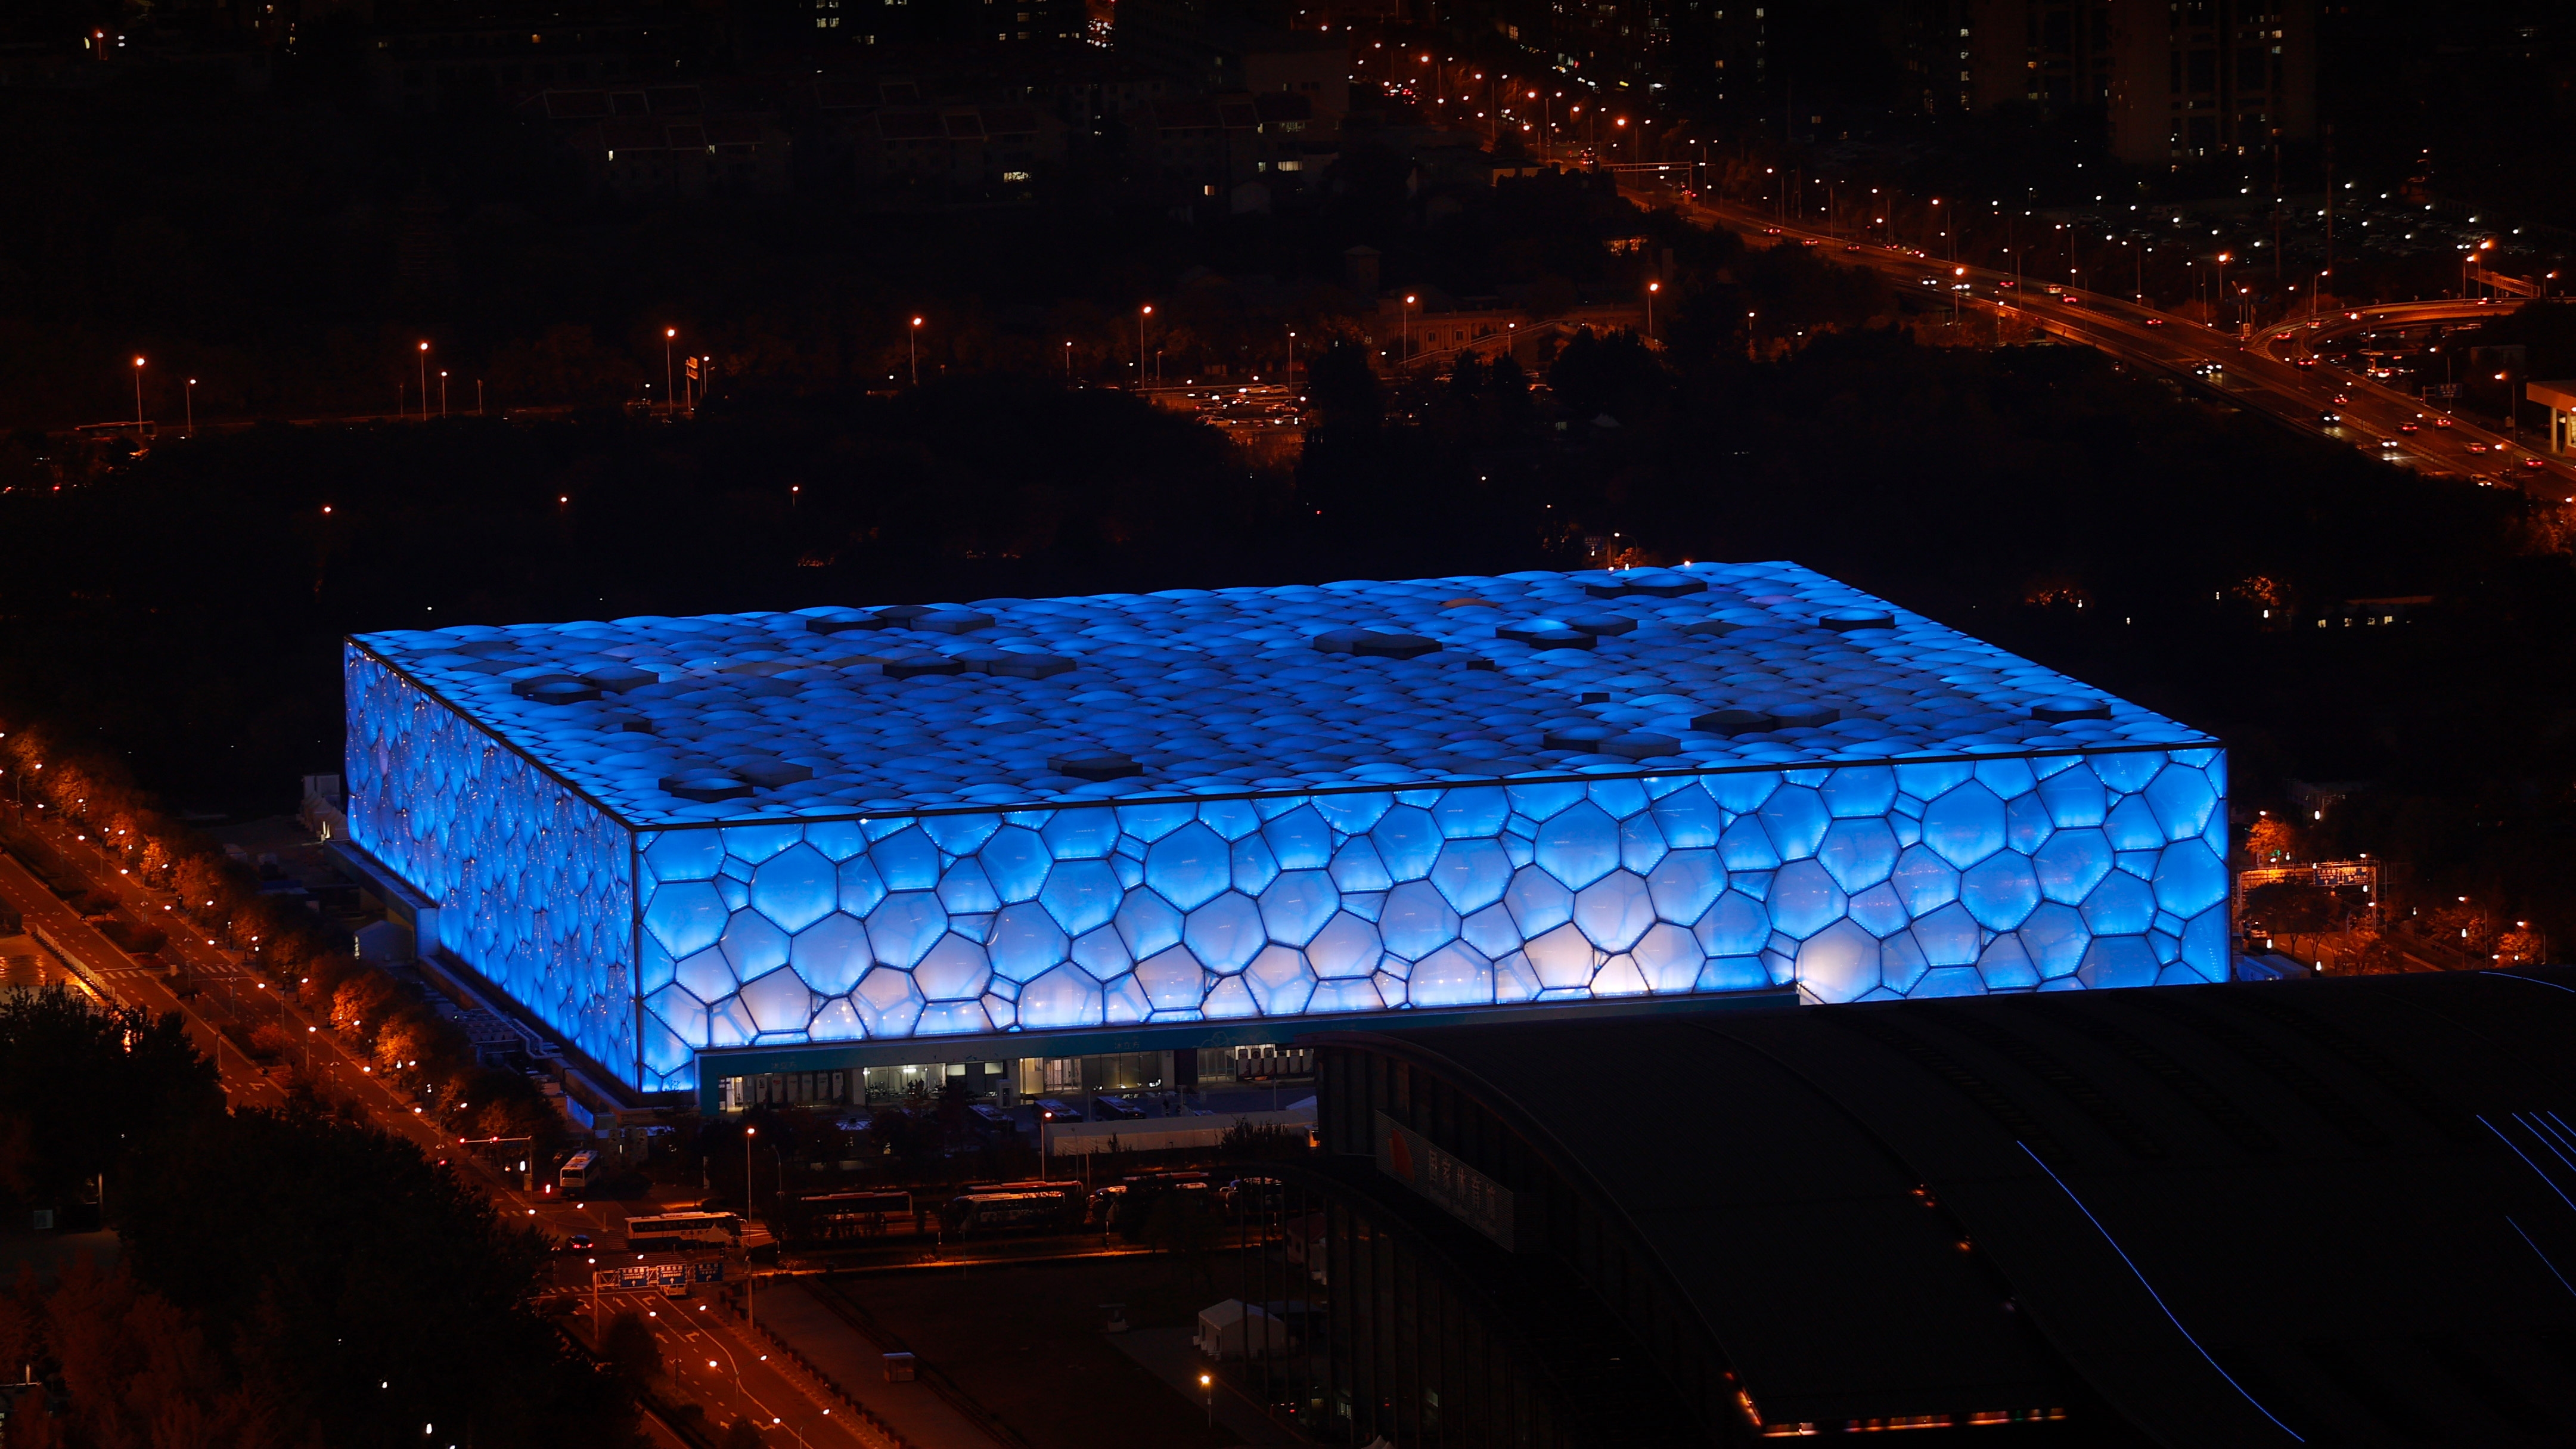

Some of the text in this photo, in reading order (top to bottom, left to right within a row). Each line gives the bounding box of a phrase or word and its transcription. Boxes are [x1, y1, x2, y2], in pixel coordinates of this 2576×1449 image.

[1429, 1150, 1496, 1220] 国家体育馆
